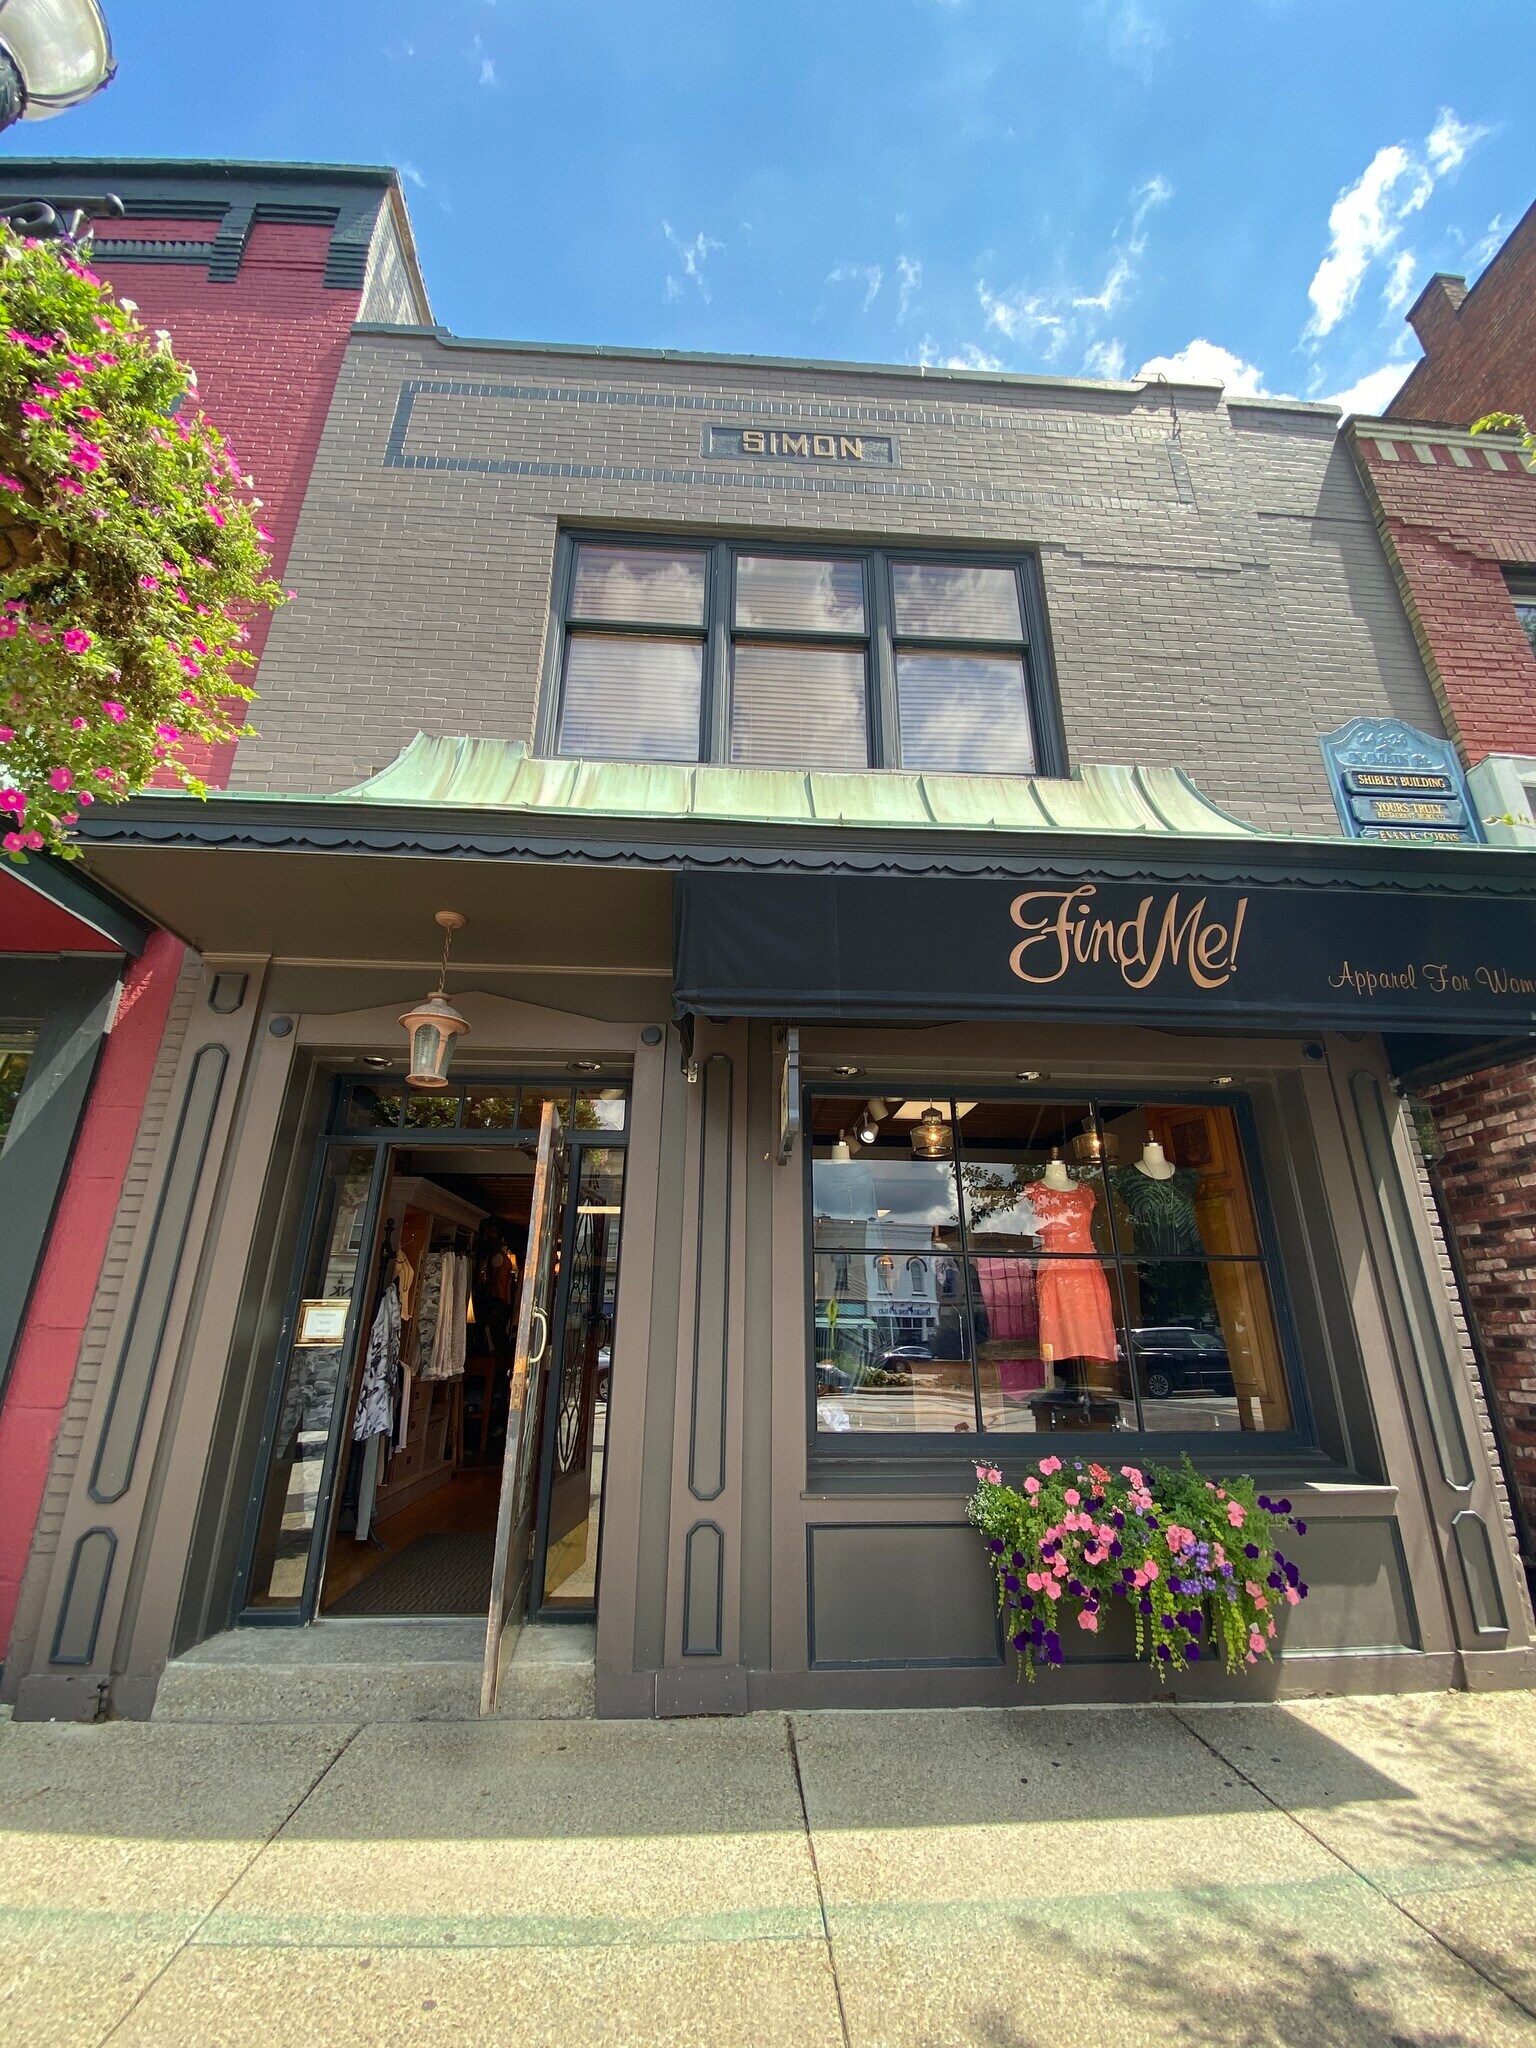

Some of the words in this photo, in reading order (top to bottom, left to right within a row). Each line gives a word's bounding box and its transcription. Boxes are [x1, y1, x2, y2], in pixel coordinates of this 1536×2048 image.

[742, 431, 861, 459] SIMON
[1357, 775, 1398, 785] SHIBLEY
[1400, 777, 1446, 788] BUILDING
[1375, 802, 1409, 812] YOURS
[1410, 804, 1442, 814] TRULY
[1009, 884, 1154, 984] Find
[1121, 892, 1248, 989] Me!
[1329, 960, 1417, 996] Apparel
[1422, 963, 1472, 992] For
[1475, 966, 1536, 994] Wom
